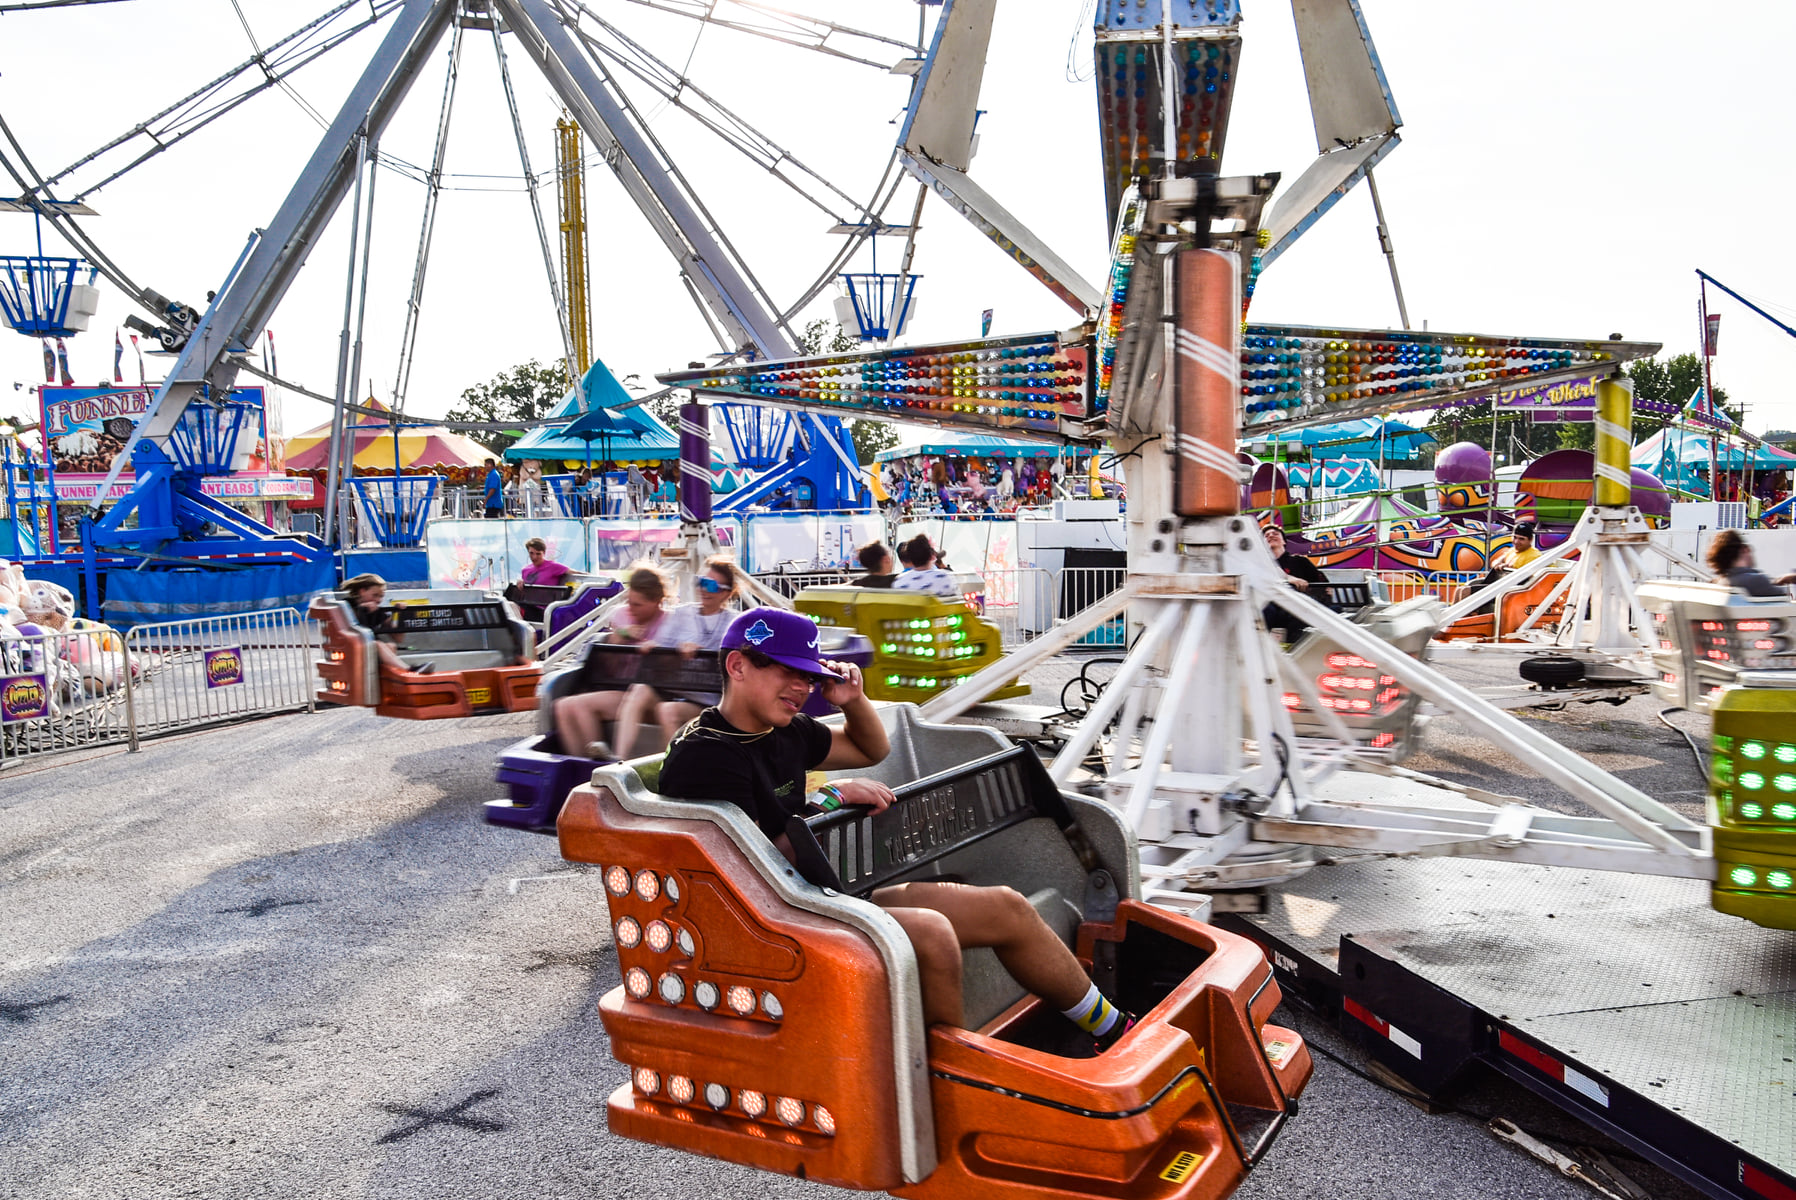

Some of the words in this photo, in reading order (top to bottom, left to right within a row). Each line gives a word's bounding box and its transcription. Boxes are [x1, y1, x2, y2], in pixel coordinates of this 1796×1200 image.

[1546, 376, 1597, 404] Whirl
[224, 482, 255, 494] EARS
[1165, 1167, 1185, 1180] NOT
[1176, 1152, 1196, 1166] STEP
